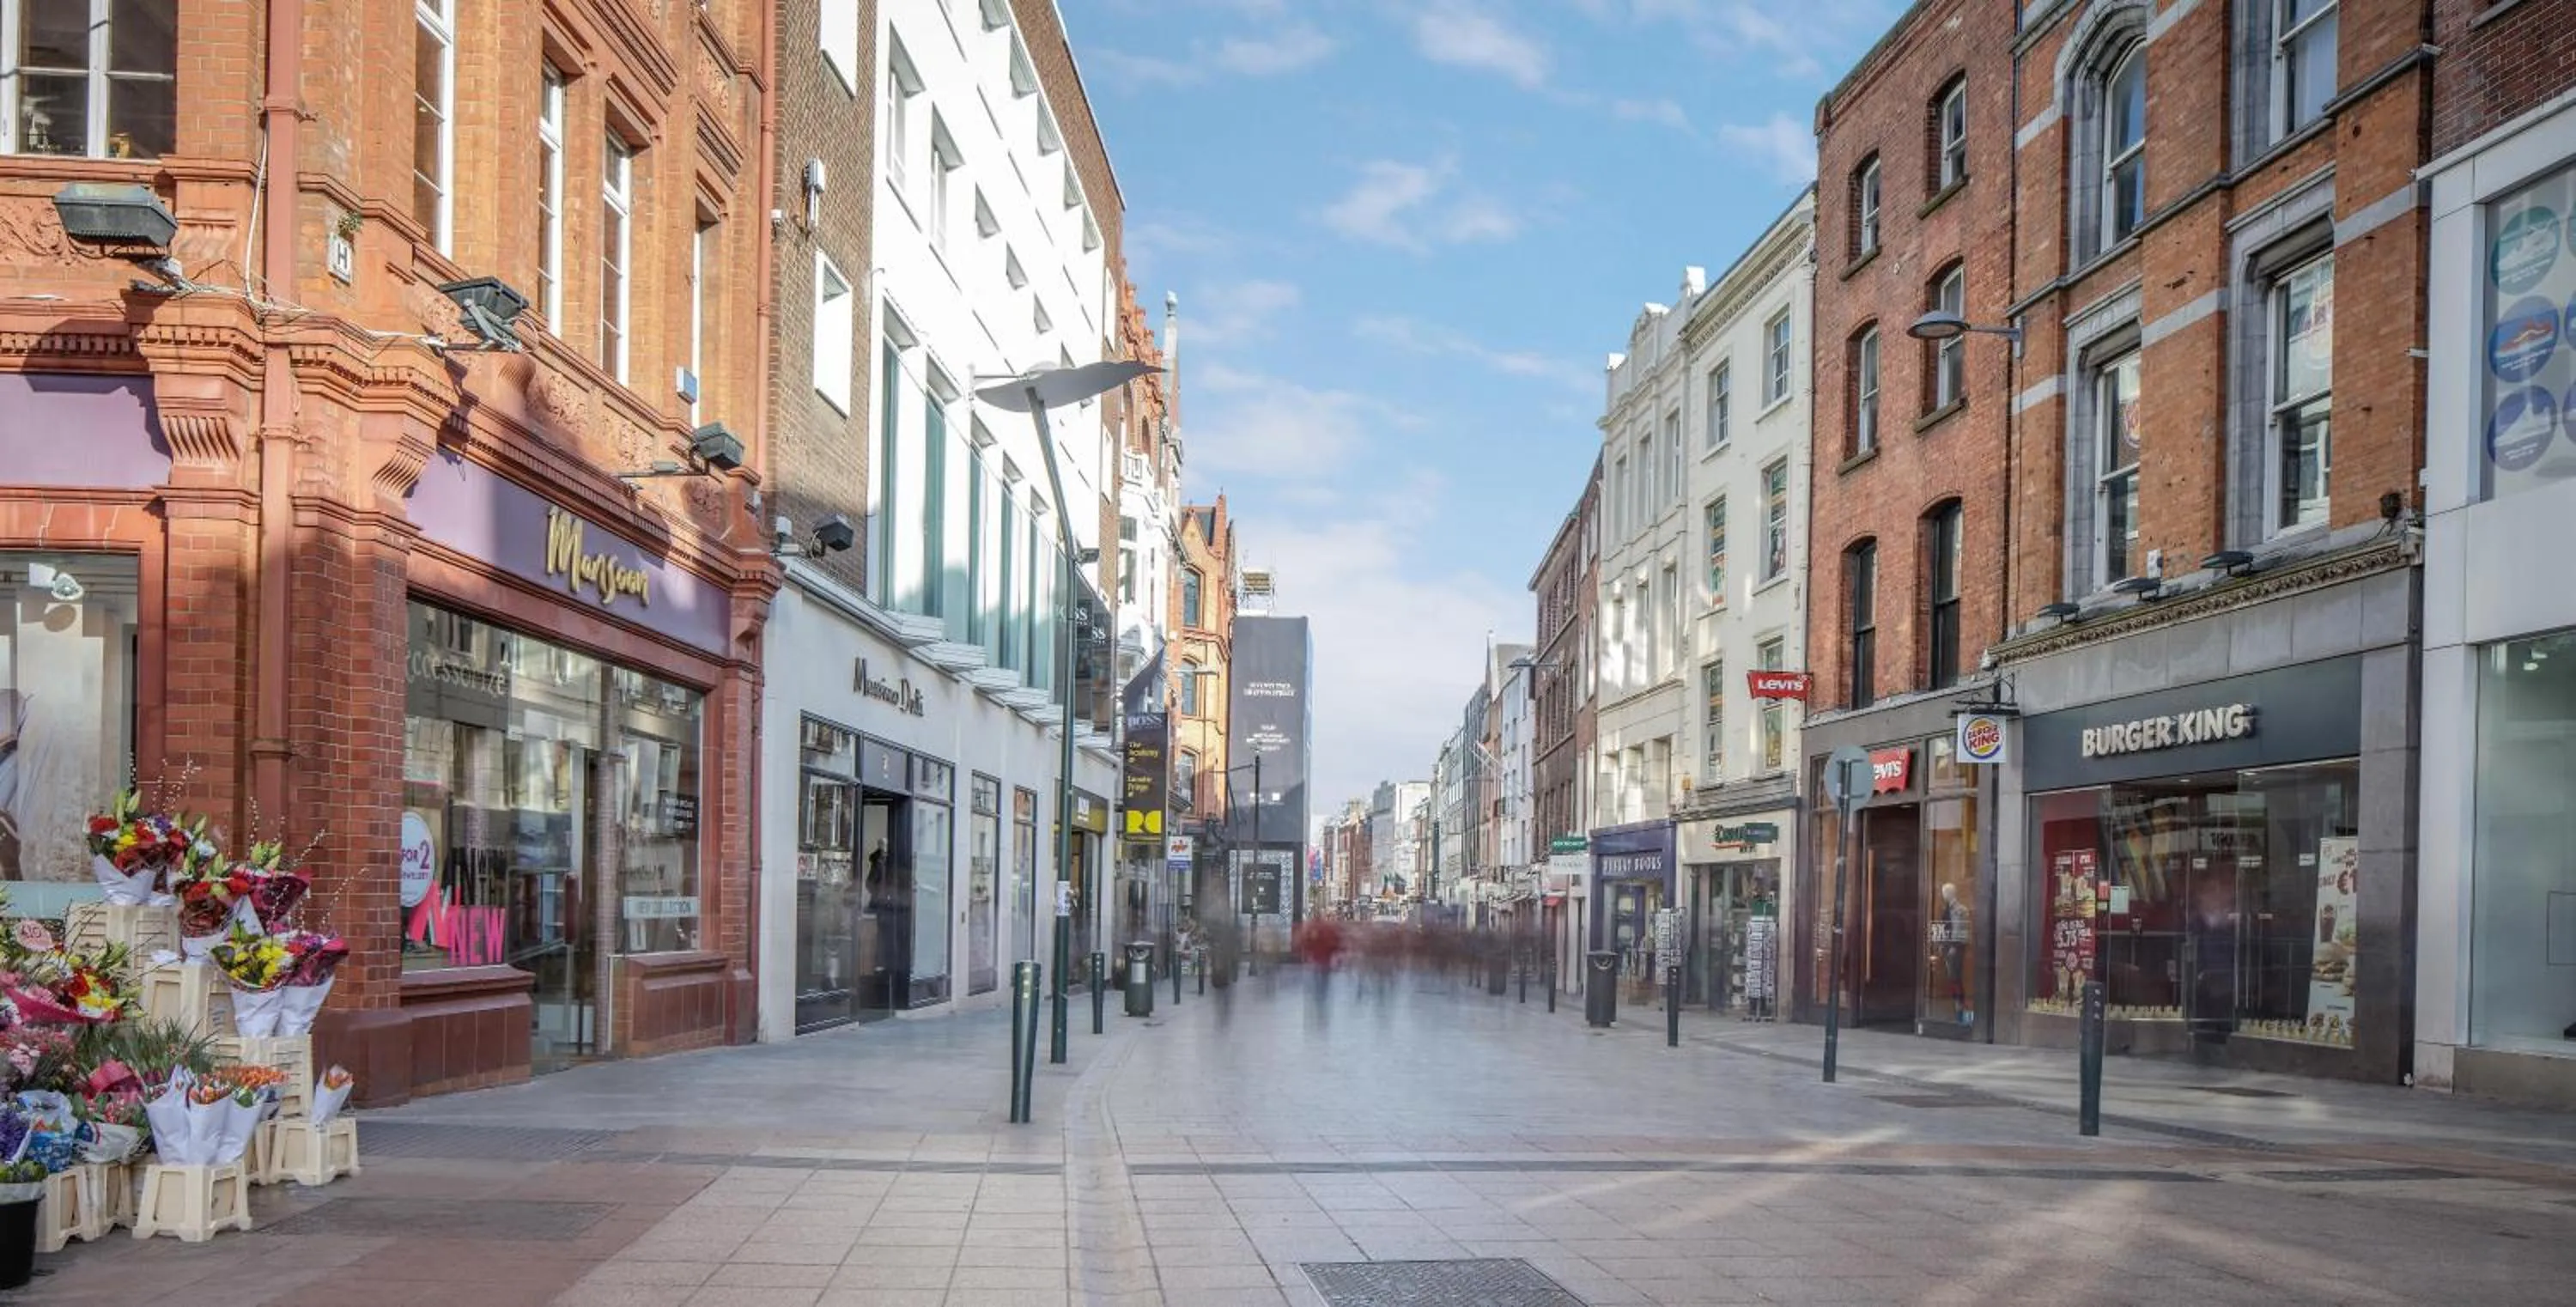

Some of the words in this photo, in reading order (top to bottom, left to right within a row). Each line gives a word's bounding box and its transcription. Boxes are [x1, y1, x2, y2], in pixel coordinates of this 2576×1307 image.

[337, 242, 349, 271] H
[546, 505, 650, 606] Monsoon
[853, 657, 899, 706] Massimo
[1969, 732, 2000, 750] KING
[2082, 715, 2172, 757] BURGER
[2177, 703, 2245, 745] KING
[419, 839, 430, 869] 2
[447, 906, 506, 966] NEW
